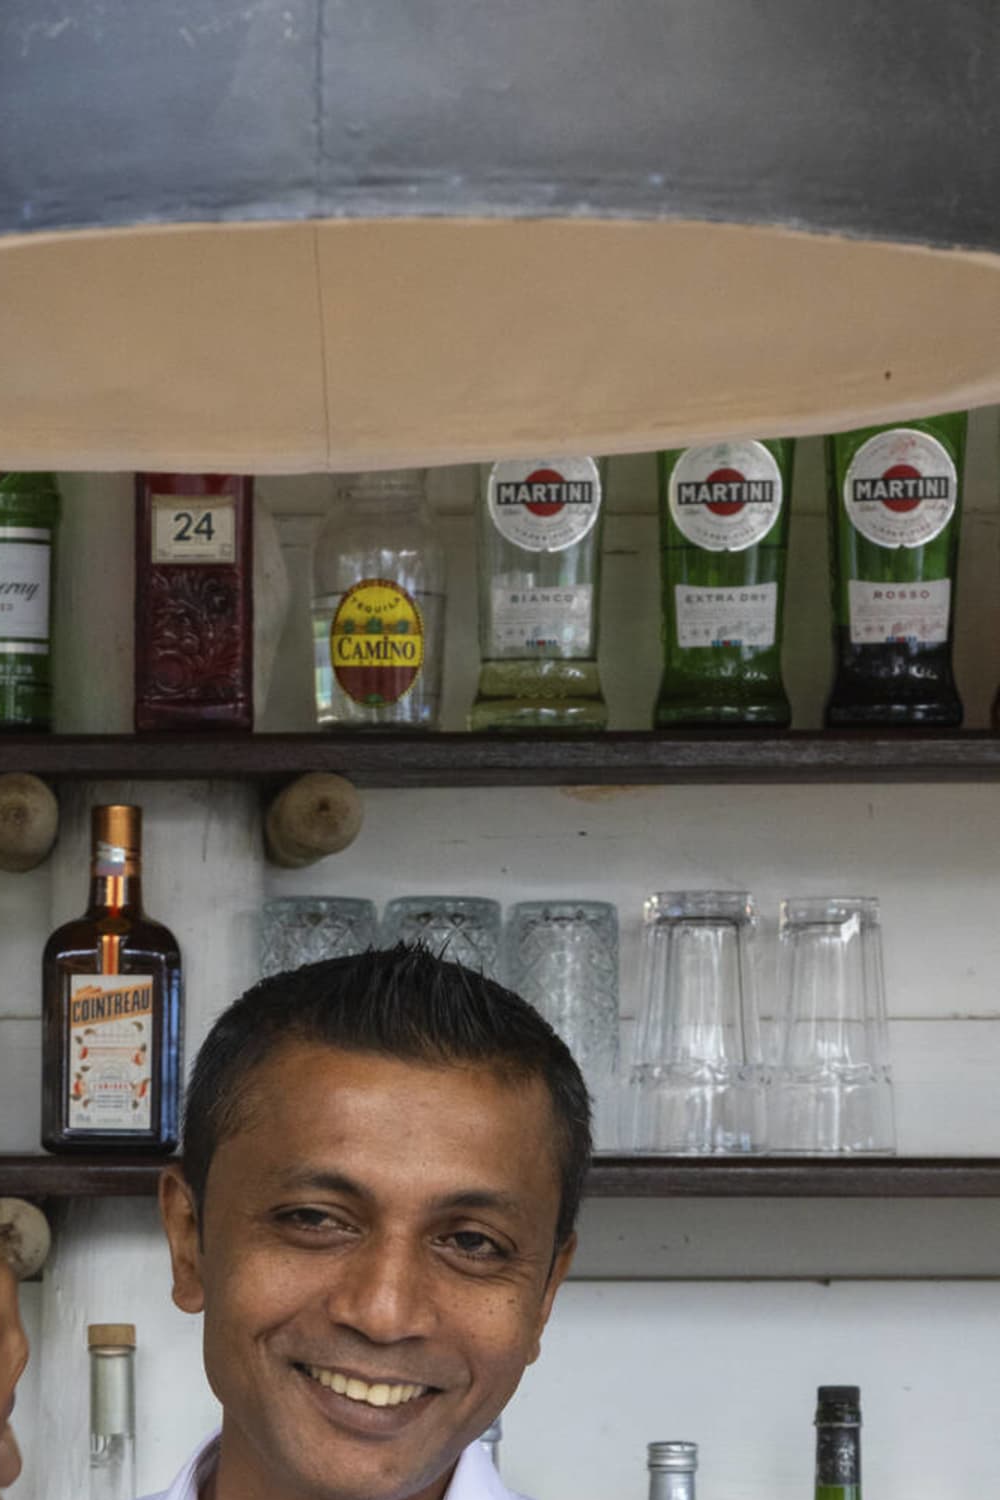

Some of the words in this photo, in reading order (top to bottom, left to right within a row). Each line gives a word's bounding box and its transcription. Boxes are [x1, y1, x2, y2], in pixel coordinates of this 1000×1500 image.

[499, 482, 590, 504] MARTINI
[679, 482, 771, 504] MARTINI
[856, 478, 947, 500] MARTINI
[173, 511, 216, 541] 24
[509, 592, 574, 604] BIANCO
[685, 593, 735, 604] EXTRA
[740, 592, 768, 603] DRY
[873, 589, 931, 600] ROSSO
[73, 988, 150, 1023] COINTREAU
